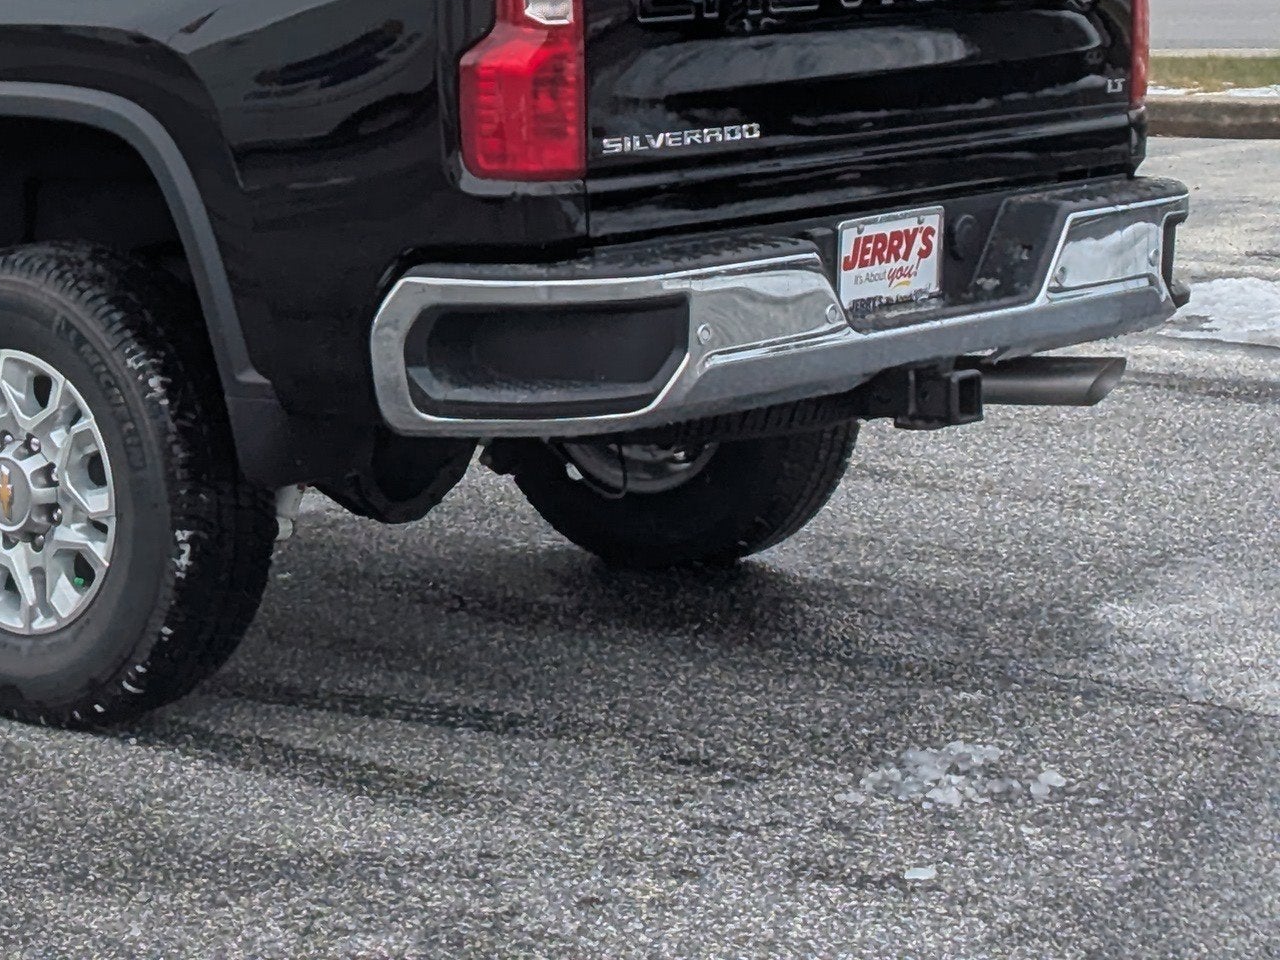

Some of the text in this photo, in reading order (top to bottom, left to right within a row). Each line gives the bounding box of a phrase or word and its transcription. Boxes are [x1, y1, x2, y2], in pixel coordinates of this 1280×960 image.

[1107, 78, 1126, 93] LT
[602, 123, 761, 154] SILVERADO
[842, 225, 936, 272] JERRY'S
[865, 270, 887, 283] About
[887, 258, 922, 288] you!
